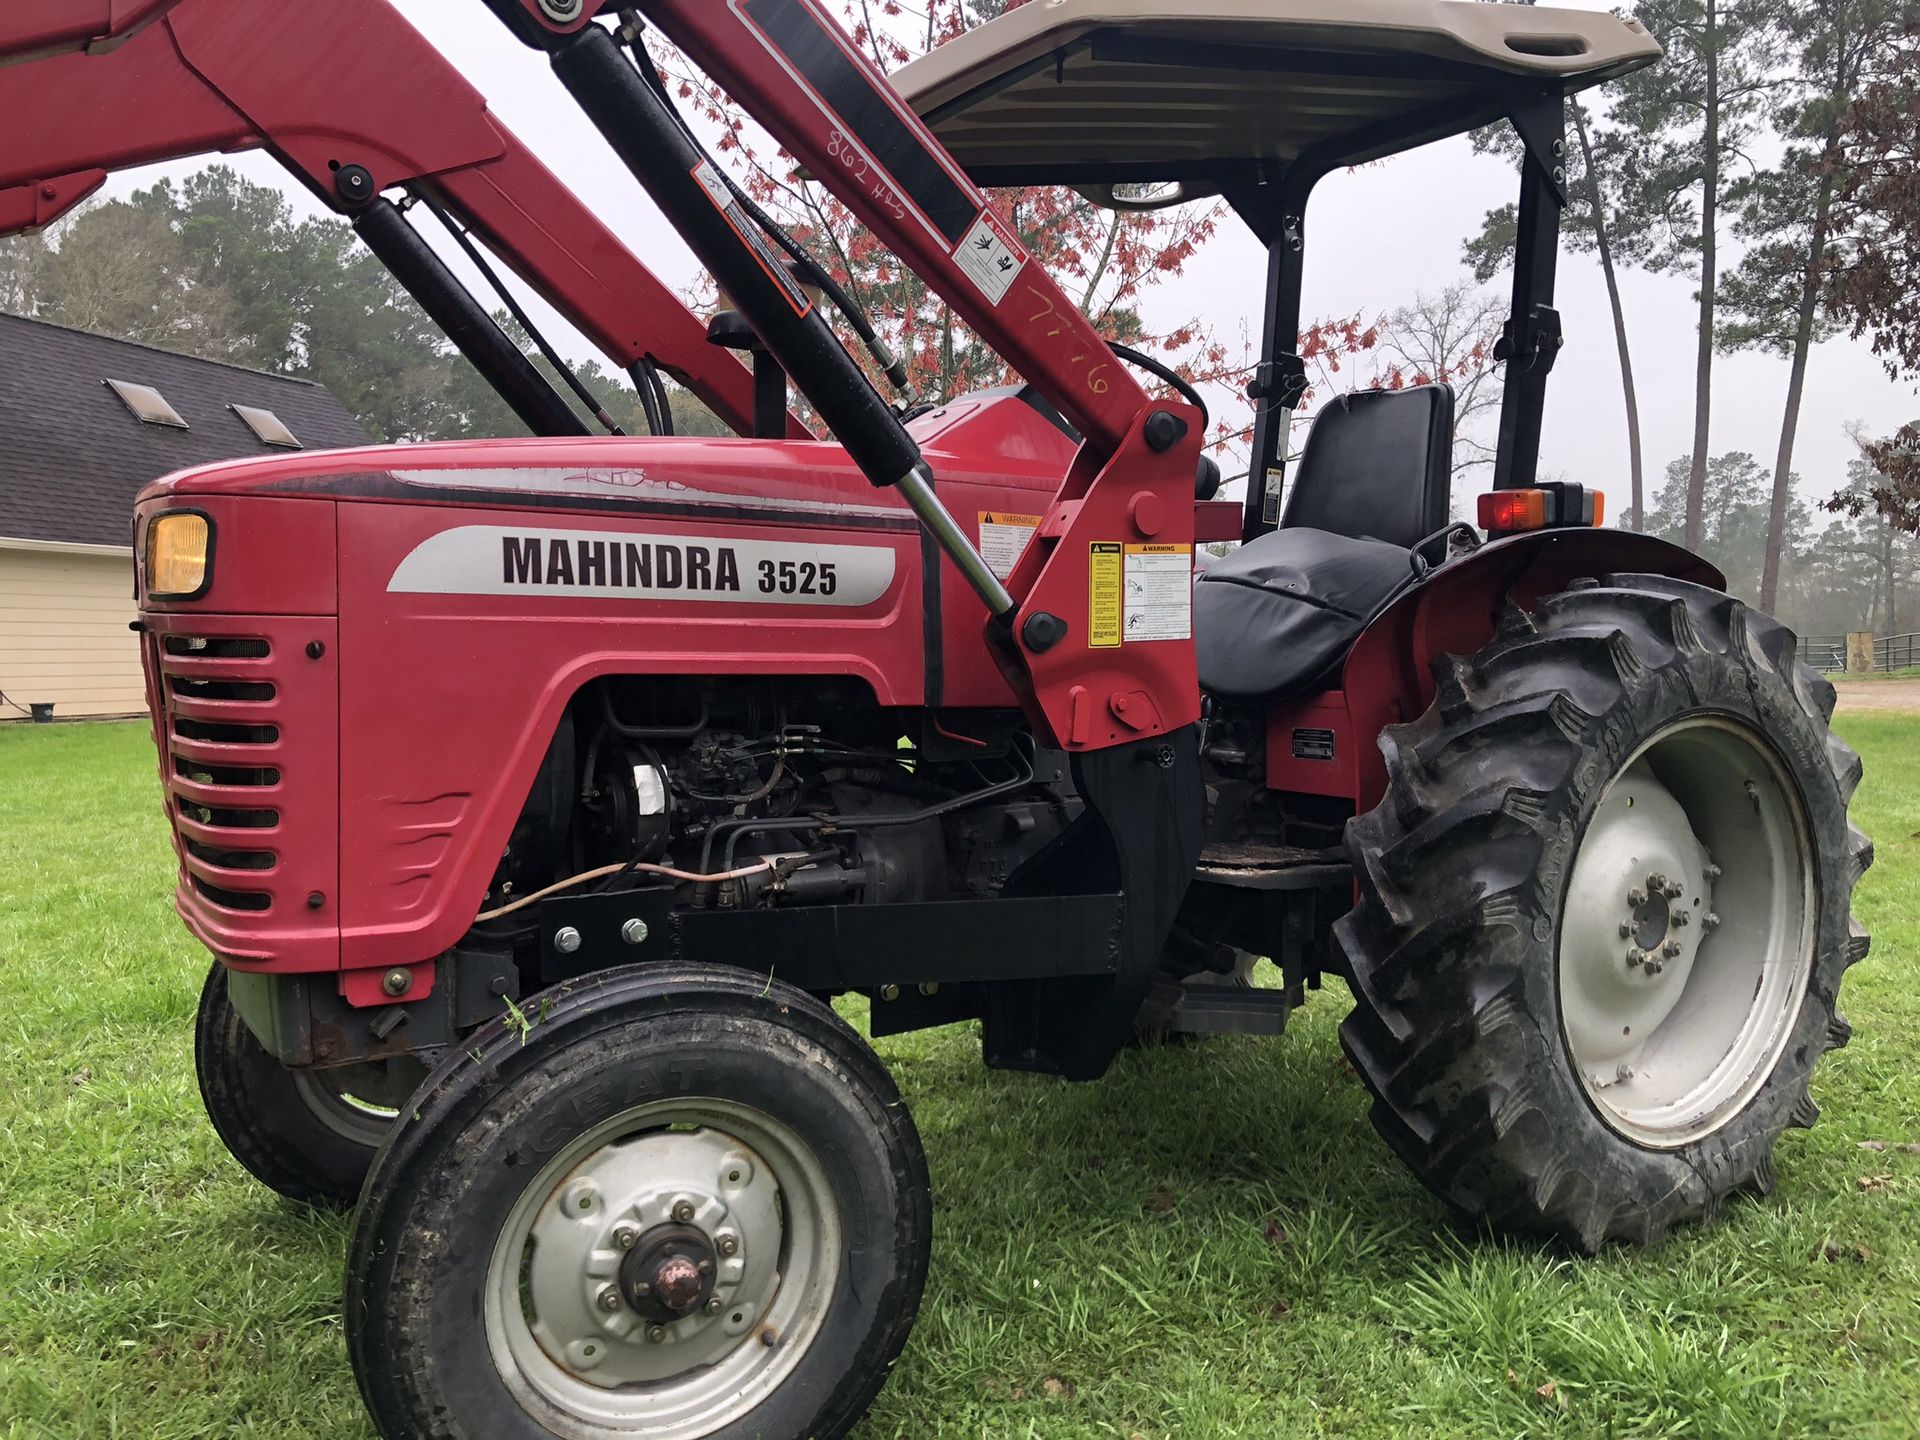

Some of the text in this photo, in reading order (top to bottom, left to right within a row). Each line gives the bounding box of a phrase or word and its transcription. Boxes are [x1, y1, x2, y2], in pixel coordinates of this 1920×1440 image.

[827, 131, 868, 183] 862
[993, 225, 1021, 258] DANGER
[1001, 515, 1037, 525] WARNING
[502, 536, 837, 596] MAHINDRA 3525
[527, 1058, 705, 1152] CEAT
